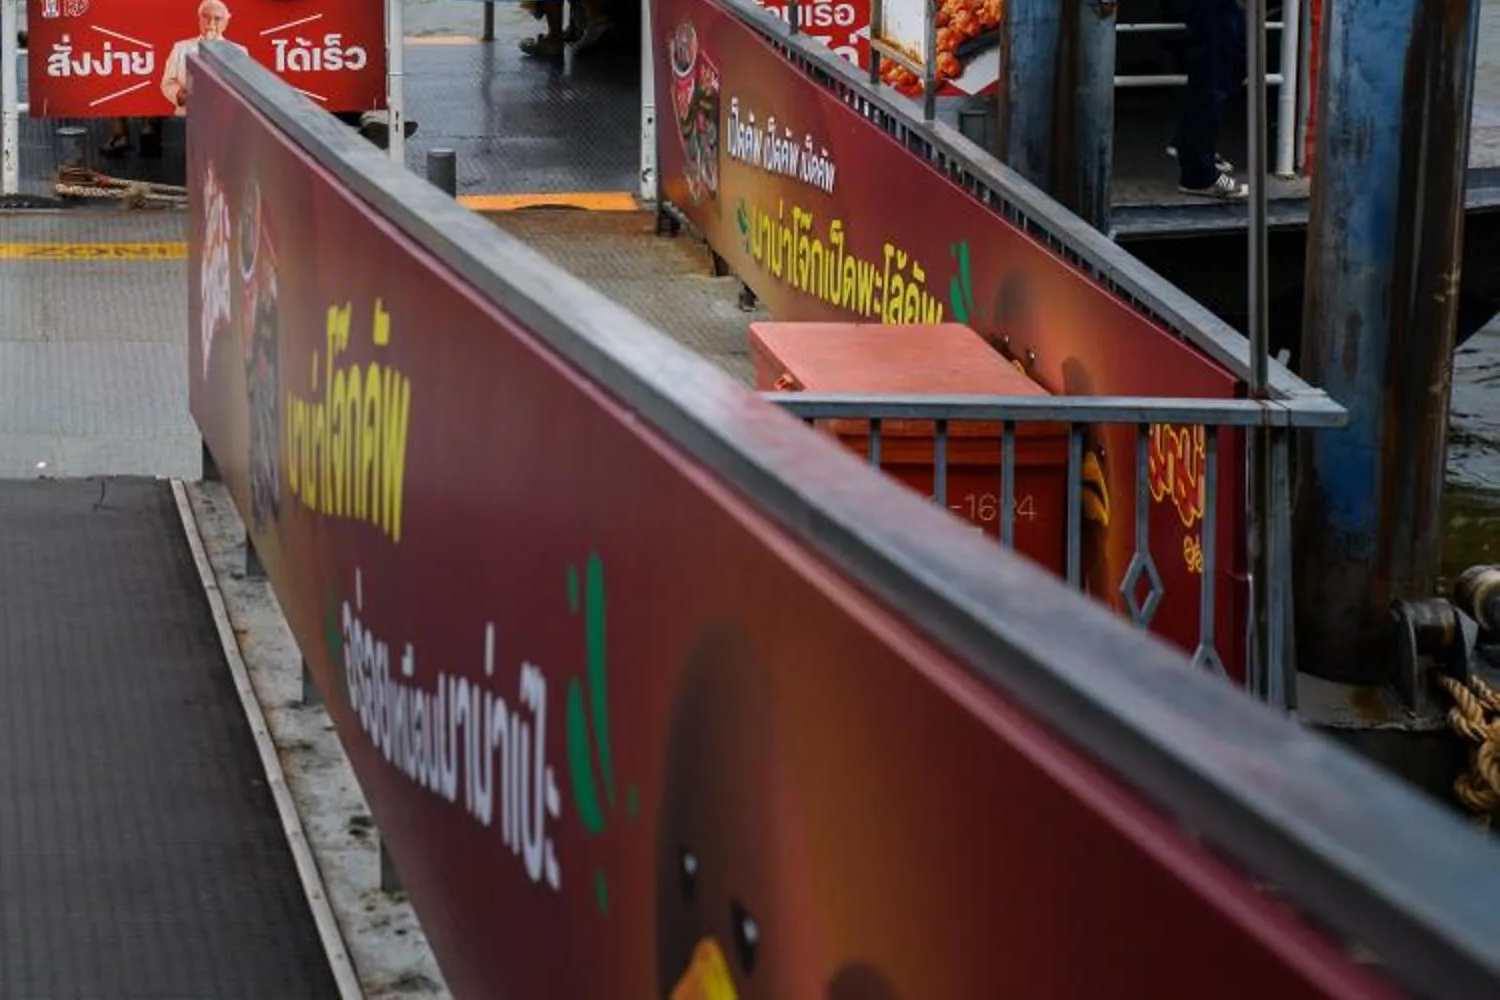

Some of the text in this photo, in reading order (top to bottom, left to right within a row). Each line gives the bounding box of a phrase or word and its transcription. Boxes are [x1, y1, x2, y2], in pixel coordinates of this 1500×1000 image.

[47, 33, 368, 77] สั่งง่าย ได้เร็ว
[950, 493, 1037, 520] -164
